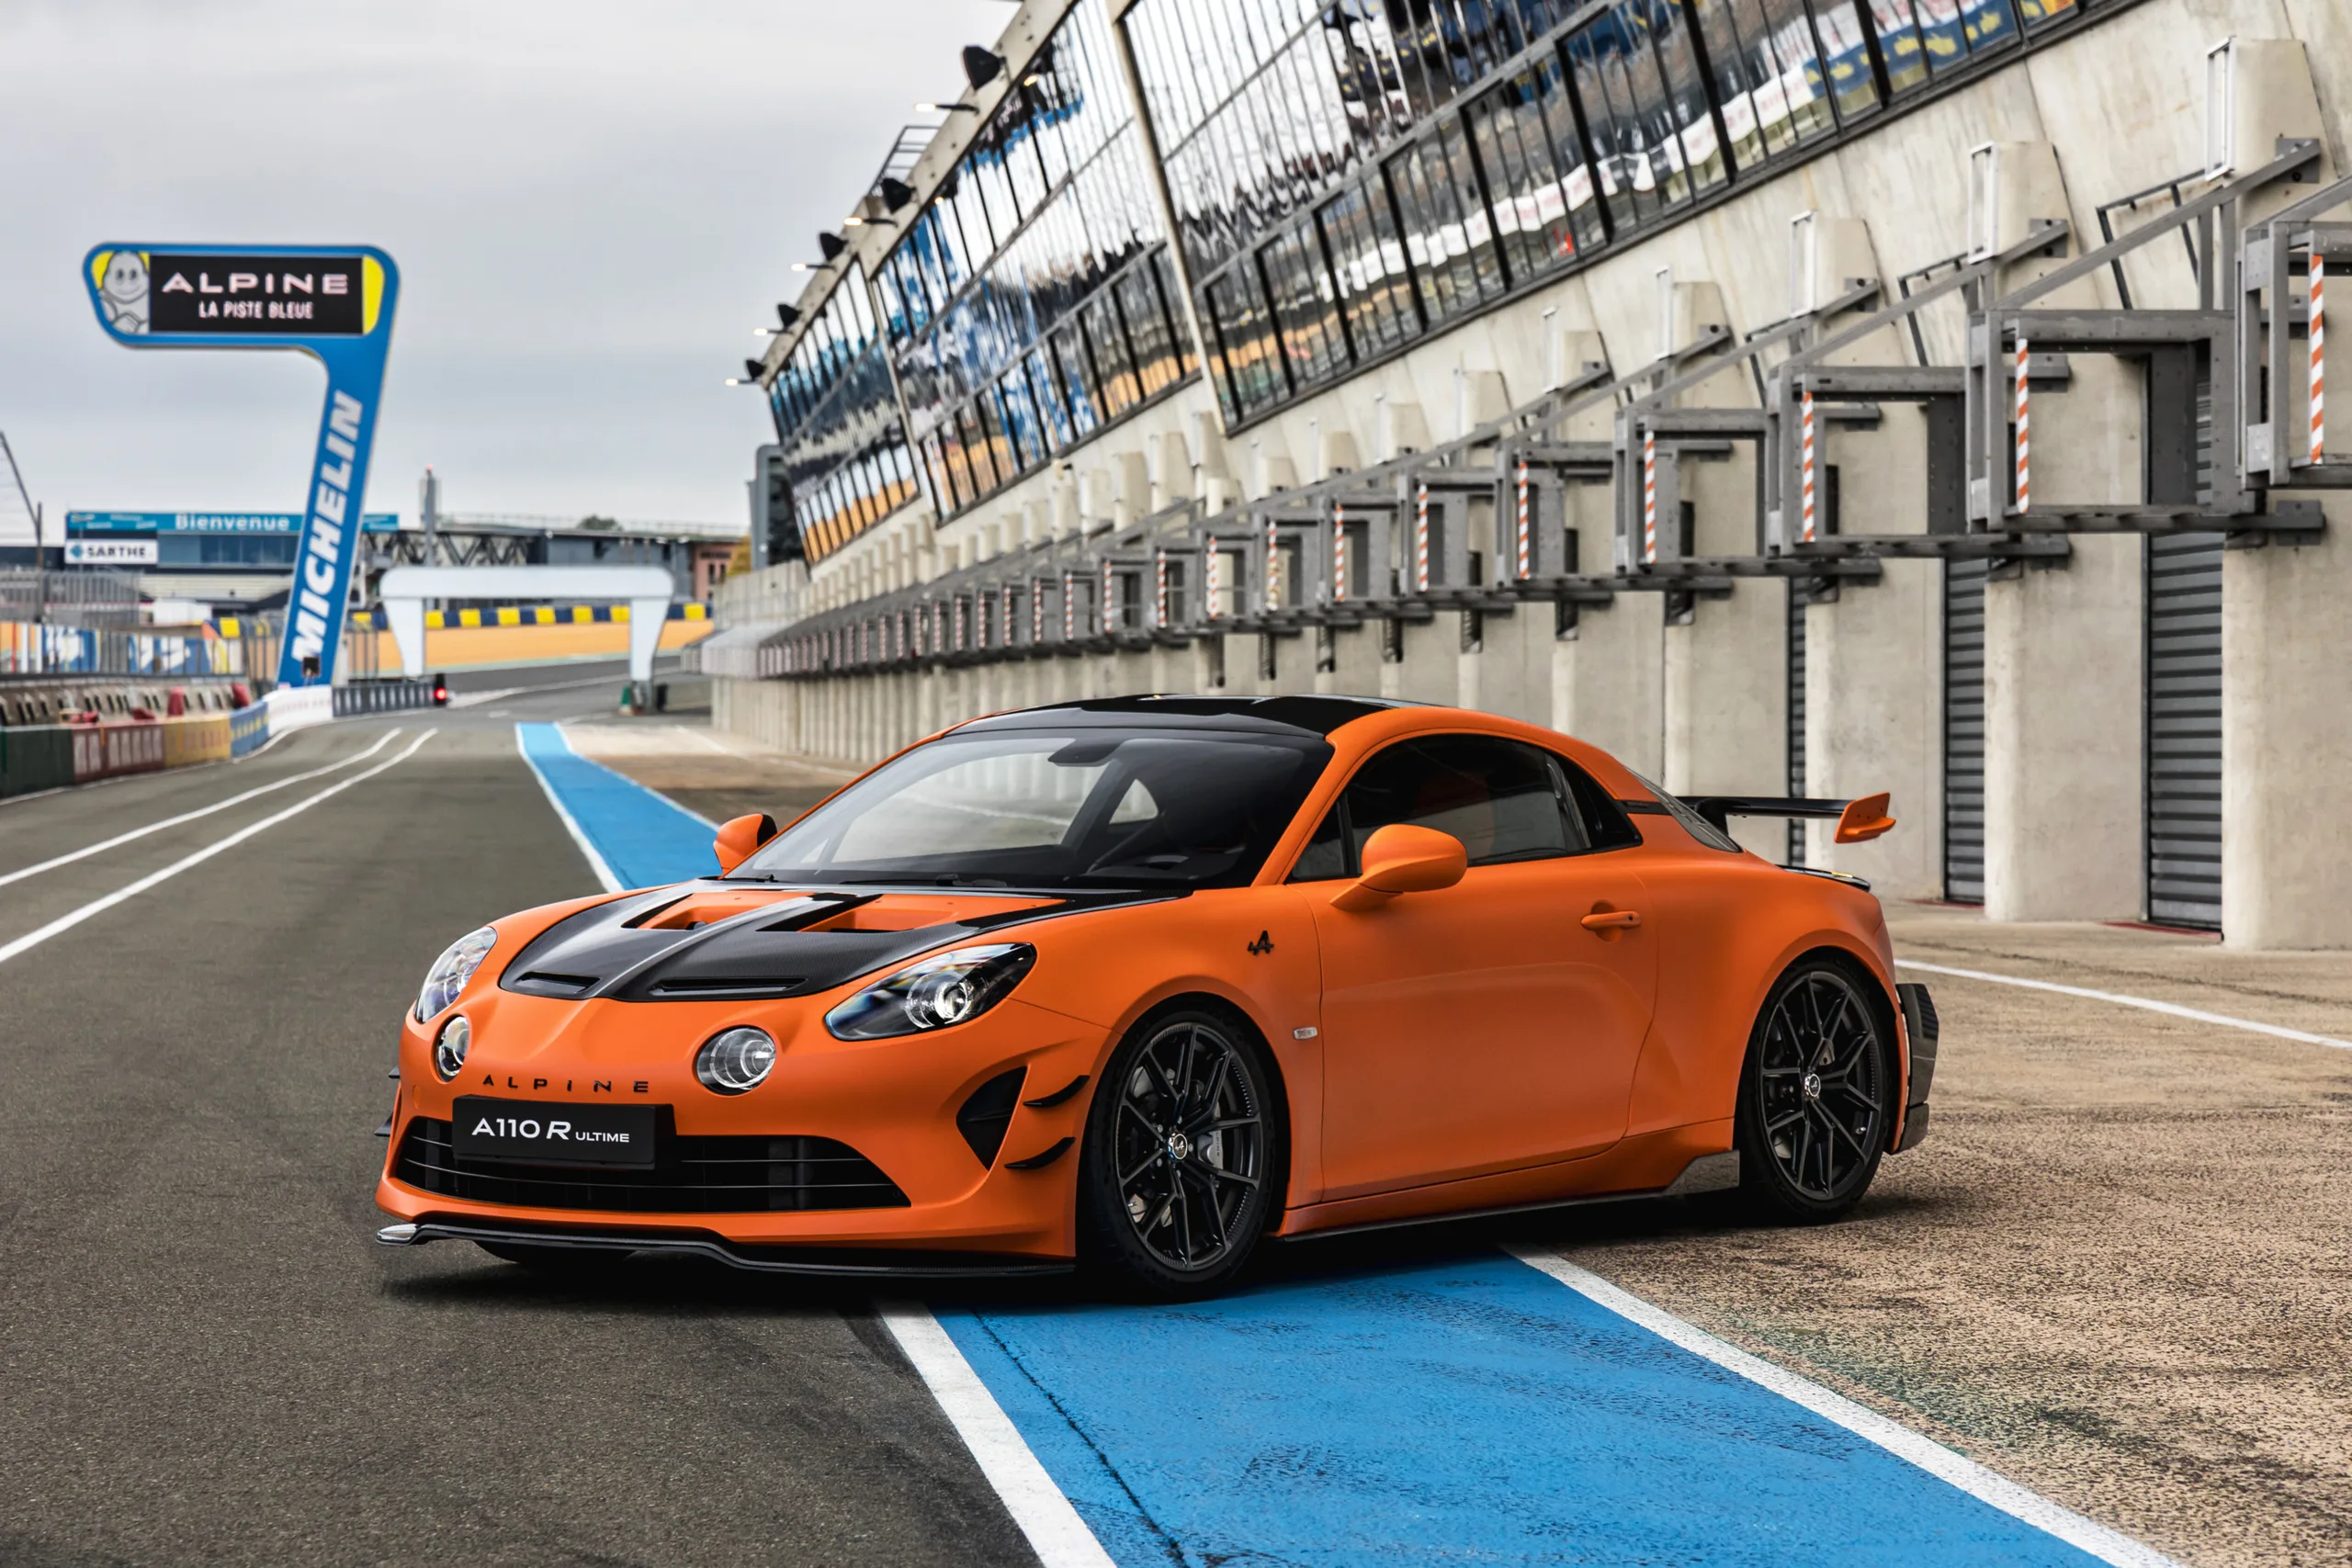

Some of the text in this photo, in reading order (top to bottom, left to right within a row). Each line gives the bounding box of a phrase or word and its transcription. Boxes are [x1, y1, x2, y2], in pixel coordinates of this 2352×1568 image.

[162, 272, 348, 294] ALPINE
[198, 299, 313, 319] LA PISTE BLEUE
[175, 514, 290, 531] Bienvenue
[291, 389, 363, 663] MICHELIN
[87, 546, 146, 558] SARTHE
[482, 1074, 649, 1093] ALPINE
[471, 1118, 629, 1143] A110 R ULTIME
